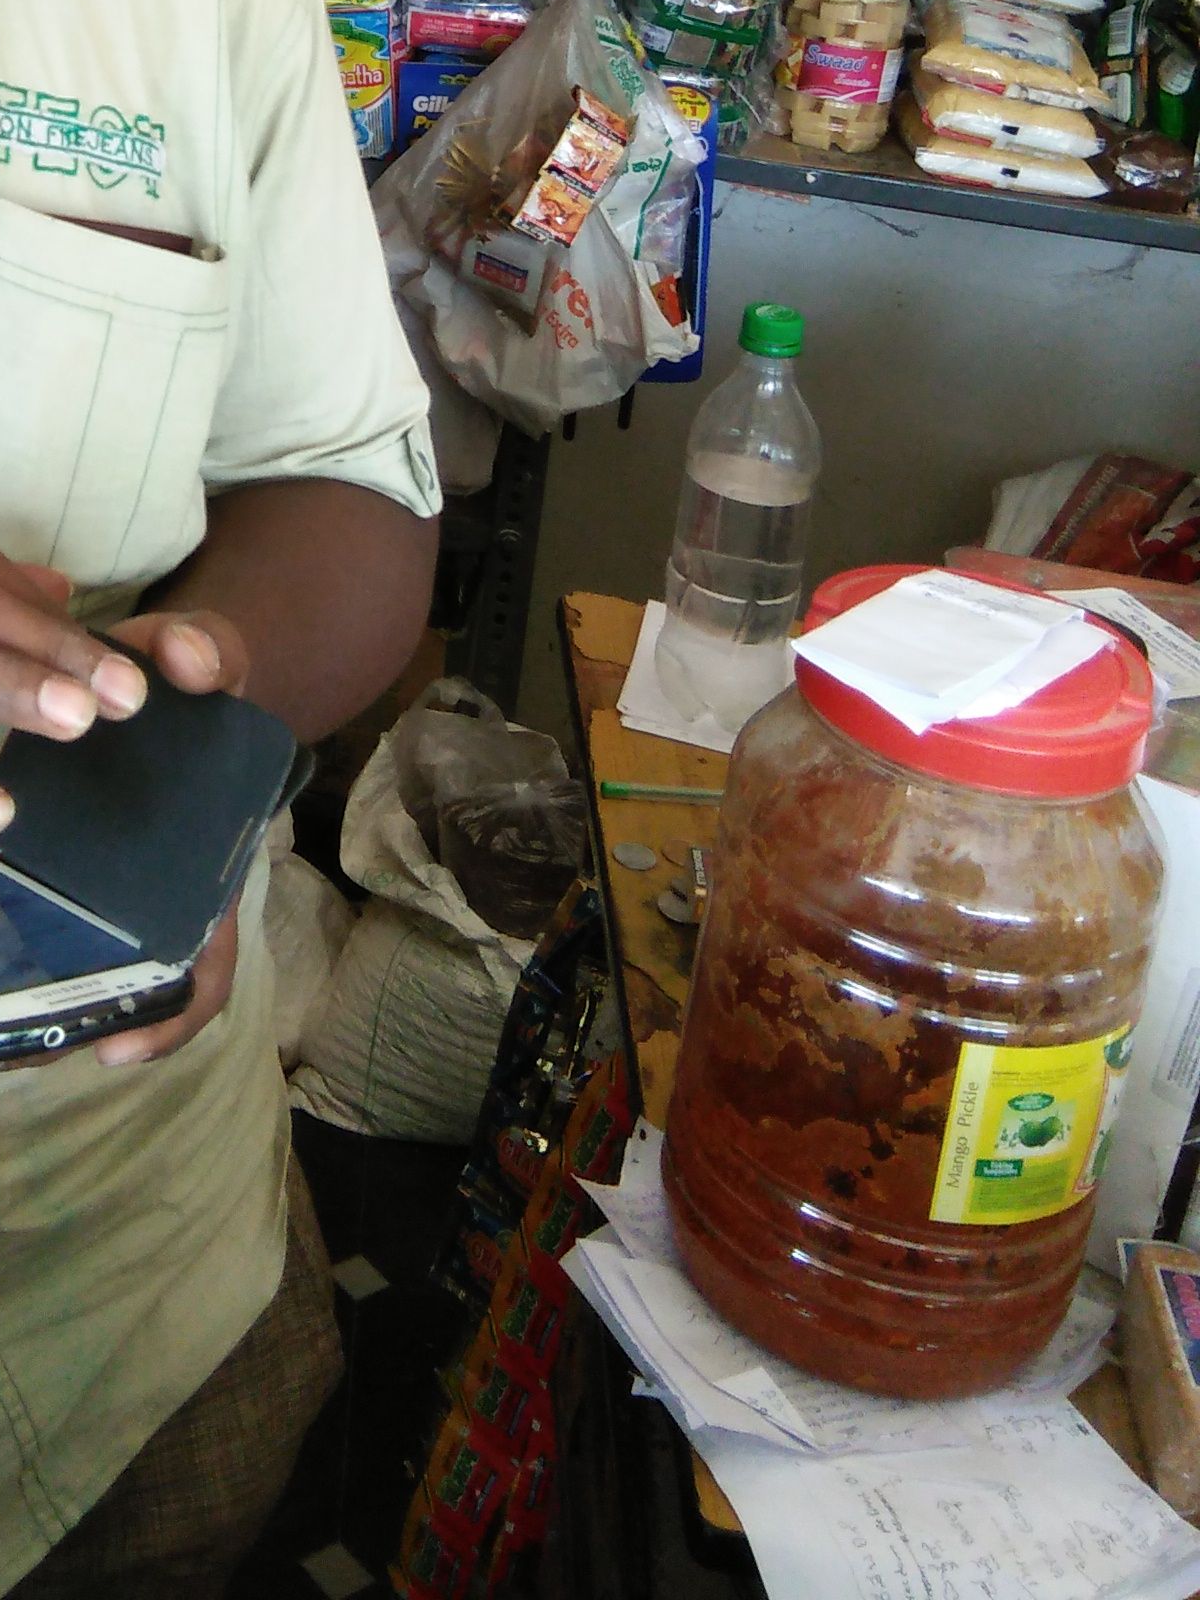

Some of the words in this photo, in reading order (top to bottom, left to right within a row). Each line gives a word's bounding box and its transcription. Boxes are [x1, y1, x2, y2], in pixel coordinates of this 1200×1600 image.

[804, 44, 866, 71] Swaad
[957, 1081, 980, 1129] Pickle
[946, 1135, 971, 1190] Mango
